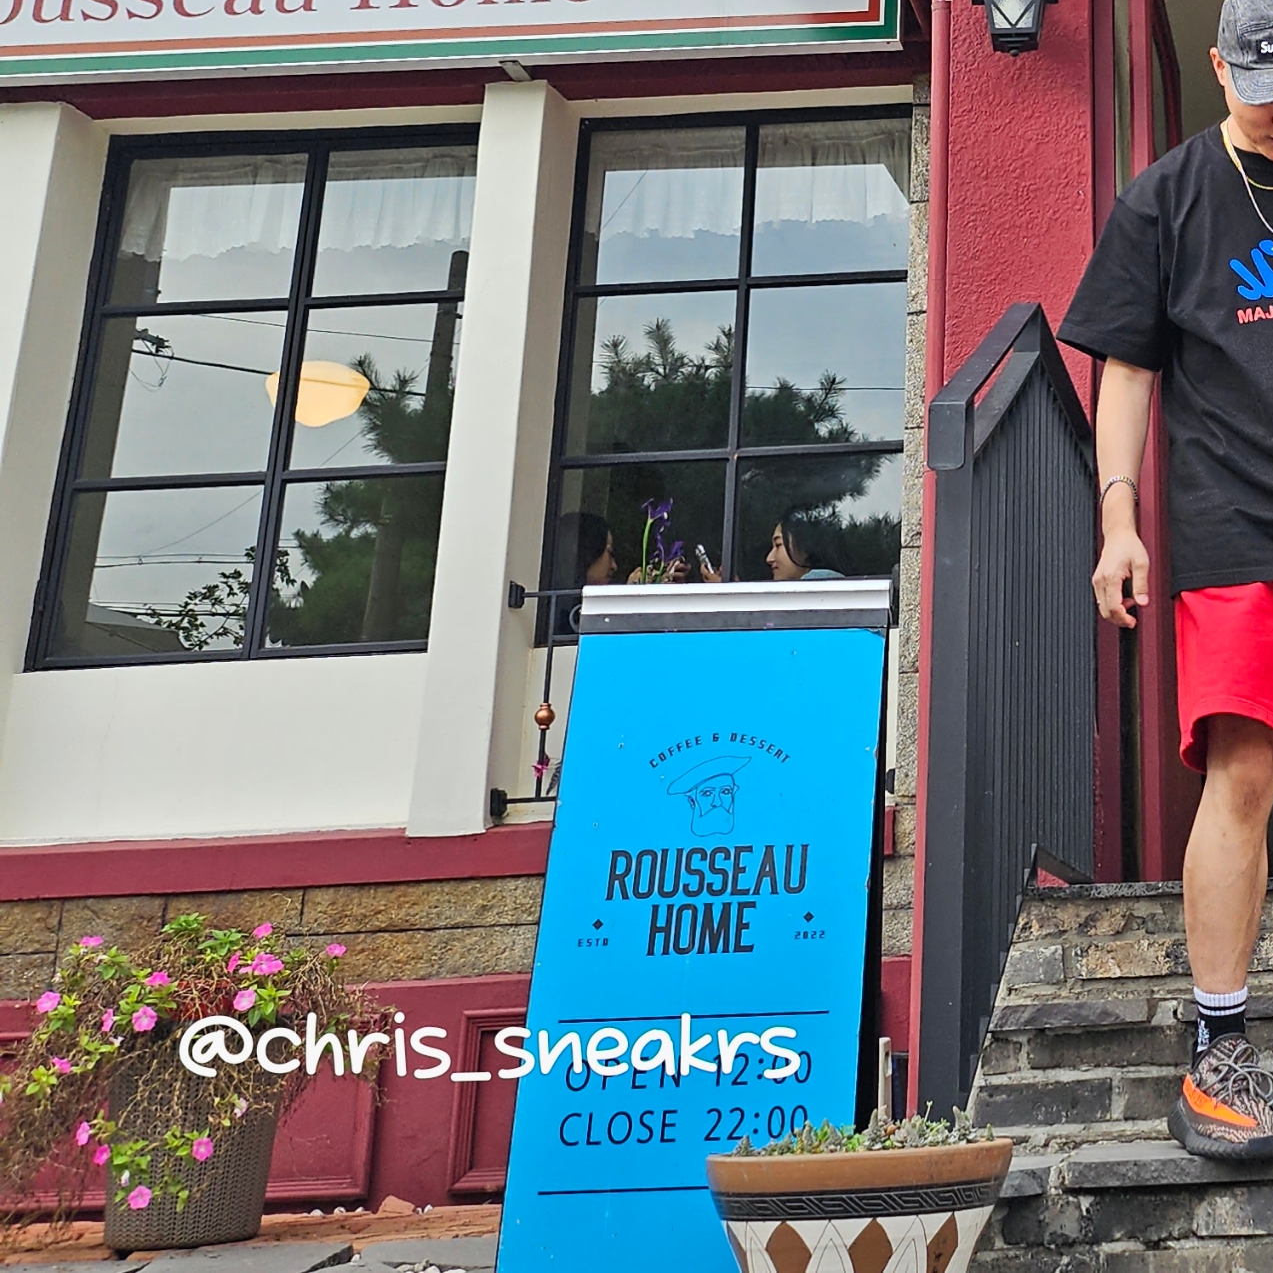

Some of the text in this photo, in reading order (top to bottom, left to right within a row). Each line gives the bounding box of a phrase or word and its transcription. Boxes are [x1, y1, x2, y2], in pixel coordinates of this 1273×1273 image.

[649, 734, 703, 769] COFFEE
[729, 731, 791, 764] DESSERT
[605, 843, 810, 902] ROUSSEAU
[577, 937, 610, 948] ESTD
[646, 900, 757, 957] HOME
[794, 929, 826, 940] 2022
[559, 1104, 808, 1147] CLOSE 22:00
